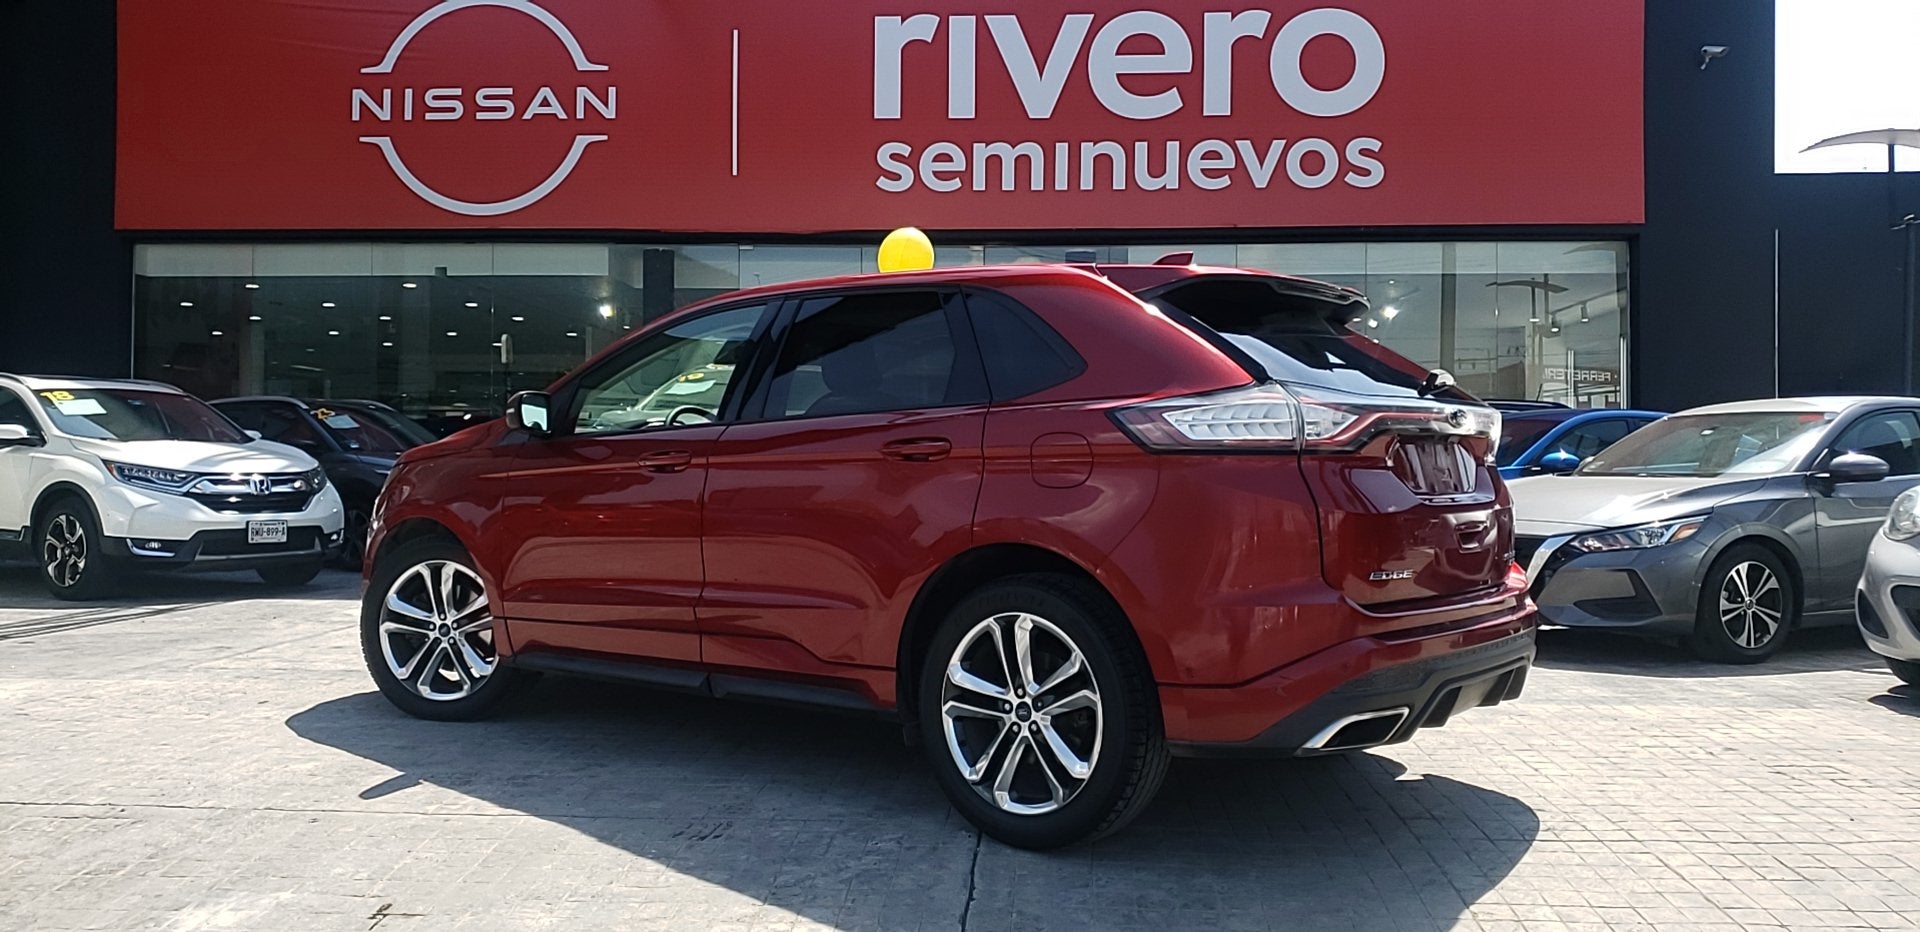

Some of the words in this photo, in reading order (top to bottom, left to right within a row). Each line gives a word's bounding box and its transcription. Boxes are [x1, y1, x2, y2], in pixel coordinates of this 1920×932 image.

[873, 8, 1385, 119] rivero
[352, 87, 616, 121] NISSAN
[875, 138, 1385, 192] seminuevos
[1369, 569, 1414, 581] EDGE
